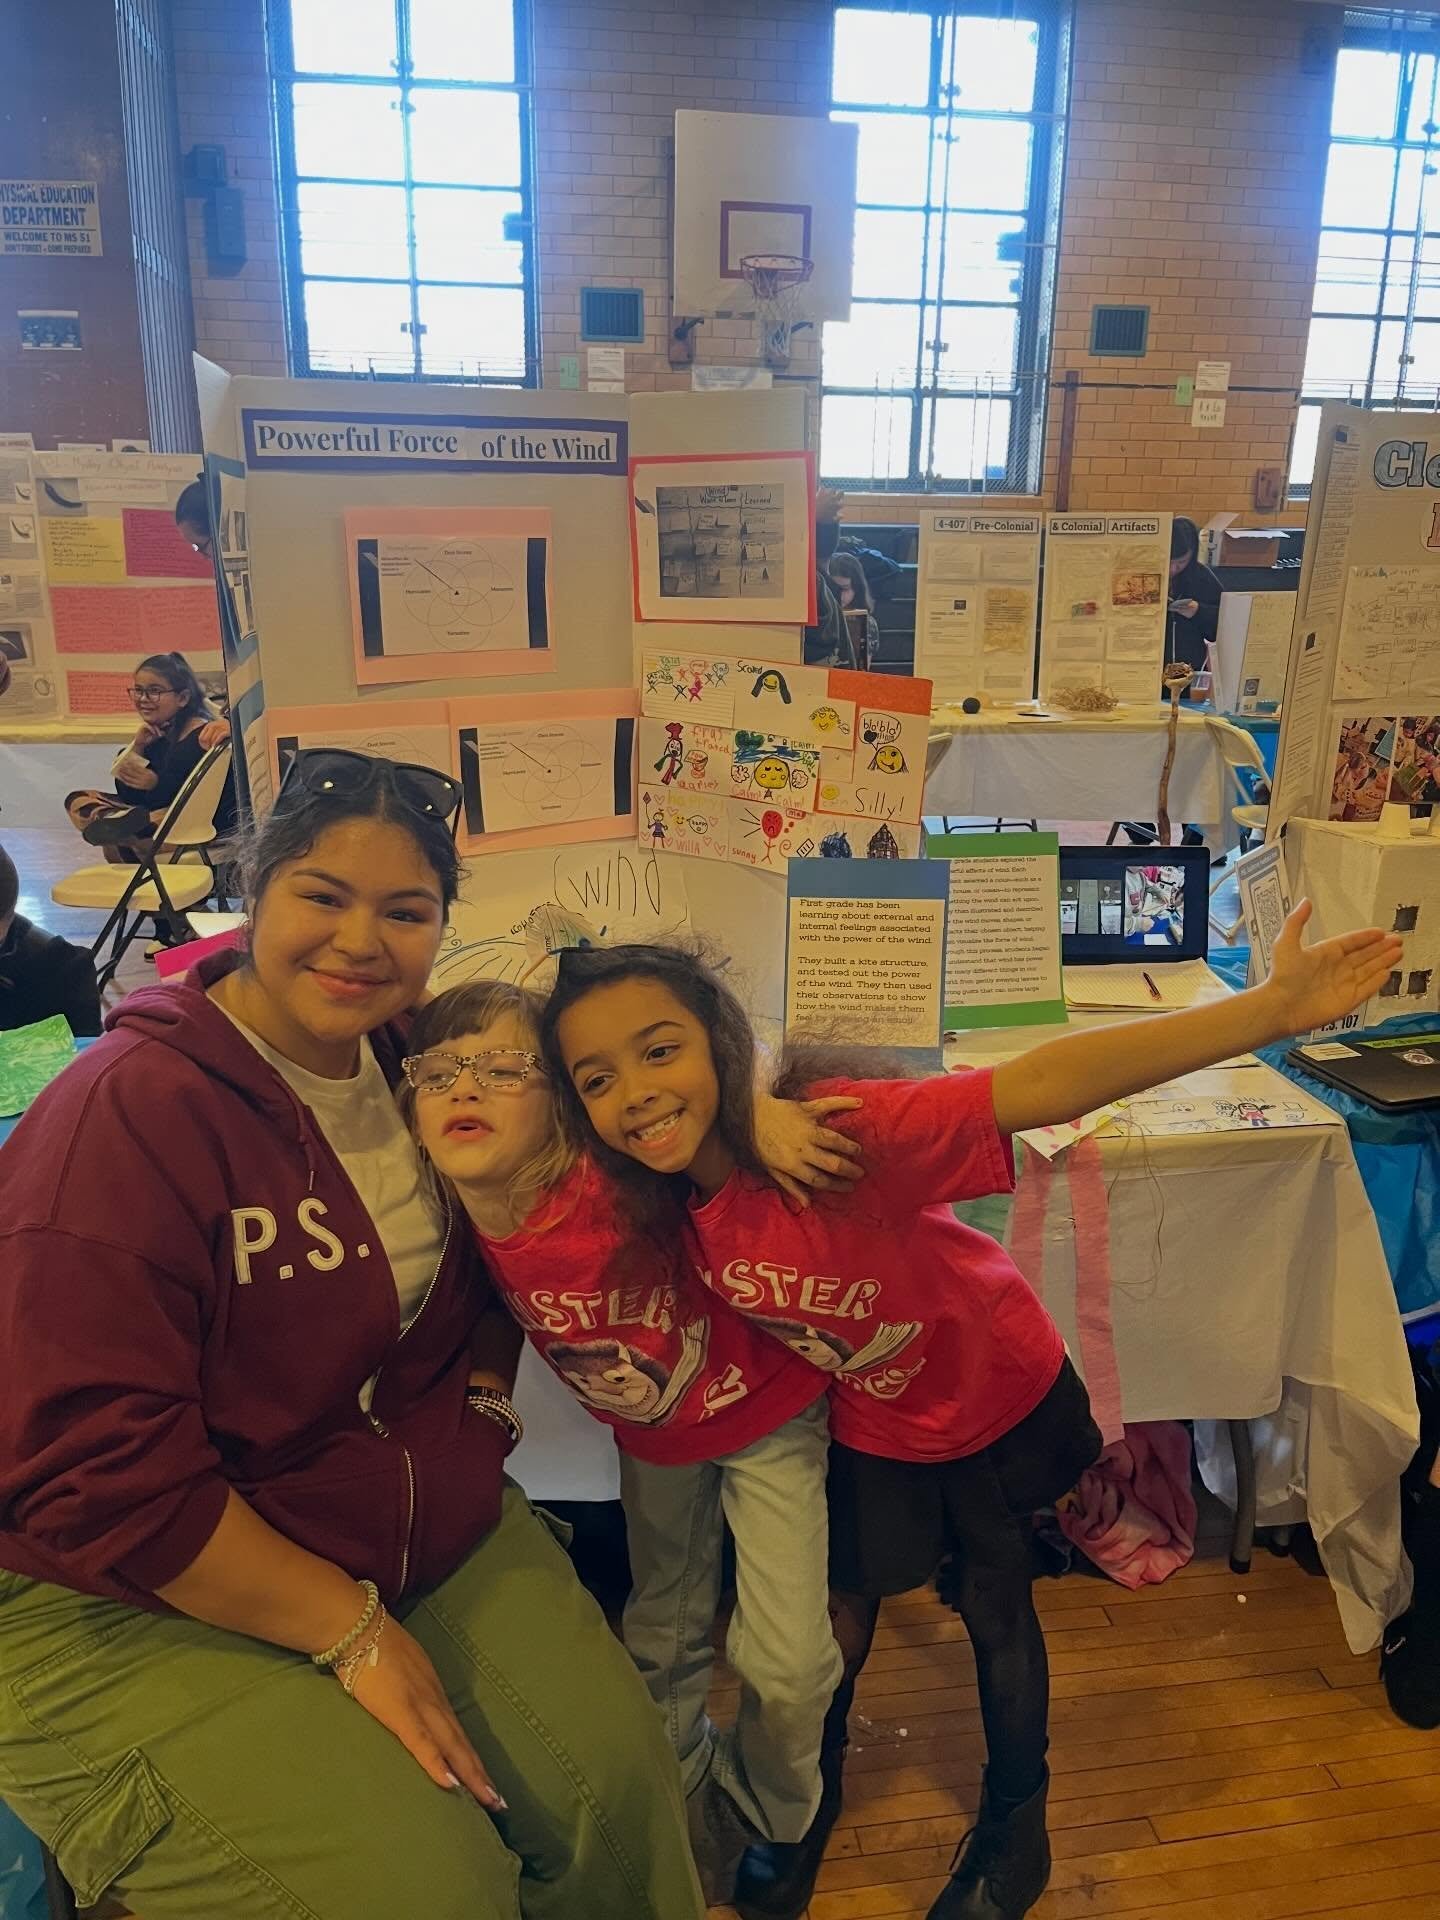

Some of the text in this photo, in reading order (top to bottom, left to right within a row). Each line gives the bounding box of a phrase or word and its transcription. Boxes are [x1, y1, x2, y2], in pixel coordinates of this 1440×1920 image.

[41, 184, 95, 205] EDUCATION
[3, 206, 86, 226] DEPARTMENT
[4, 231, 49, 242] WELCOME
[50, 232, 62, 242] TO
[64, 232, 78, 242] MS
[257, 424, 612, 462] Powerful Force of the Wind
[938, 519, 1034, 531] 4-407 Pre-Colonial
[1052, 521, 1156, 532] & Colonial Artifacts
[854, 786, 906, 821] Silly!
[731, 847, 757, 864] sunny
[800, 899, 900, 909] First grade has been
[799, 910, 935, 921] learning about external and
[799, 922, 931, 933] internal feelings associated
[798, 933, 821, 942] with
[823, 934, 840, 942] the
[843, 935, 872, 944] power
[875, 935, 886, 943] of
[888, 935, 905, 943] the
[797, 956, 822, 966] They
[824, 957, 846, 966] built
[858, 958, 878, 966] kite
[797, 967, 816, 976] and
[818, 968, 850, 977] tested
[872, 969, 889, 978] the
[891, 970, 921, 979] power
[796, 979, 807, 987] of
[809, 979, 826, 987] the
[856, 980, 881, 990] They
[883, 981, 906, 989] then
[908, 982, 932, 990] used
[796, 990, 926, 1001] their observations to show
[795, 1002, 817, 1010] how
[819, 1002, 836, 1011] the
[839, 1003, 862, 1012] wind
[898, 1004, 926, 1013] them
[1341, 1014, 1359, 1030] 107
[231, 1197, 370, 1285] P.S.
[698, 1258, 881, 1321] STER
[505, 1284, 677, 1335] STER
